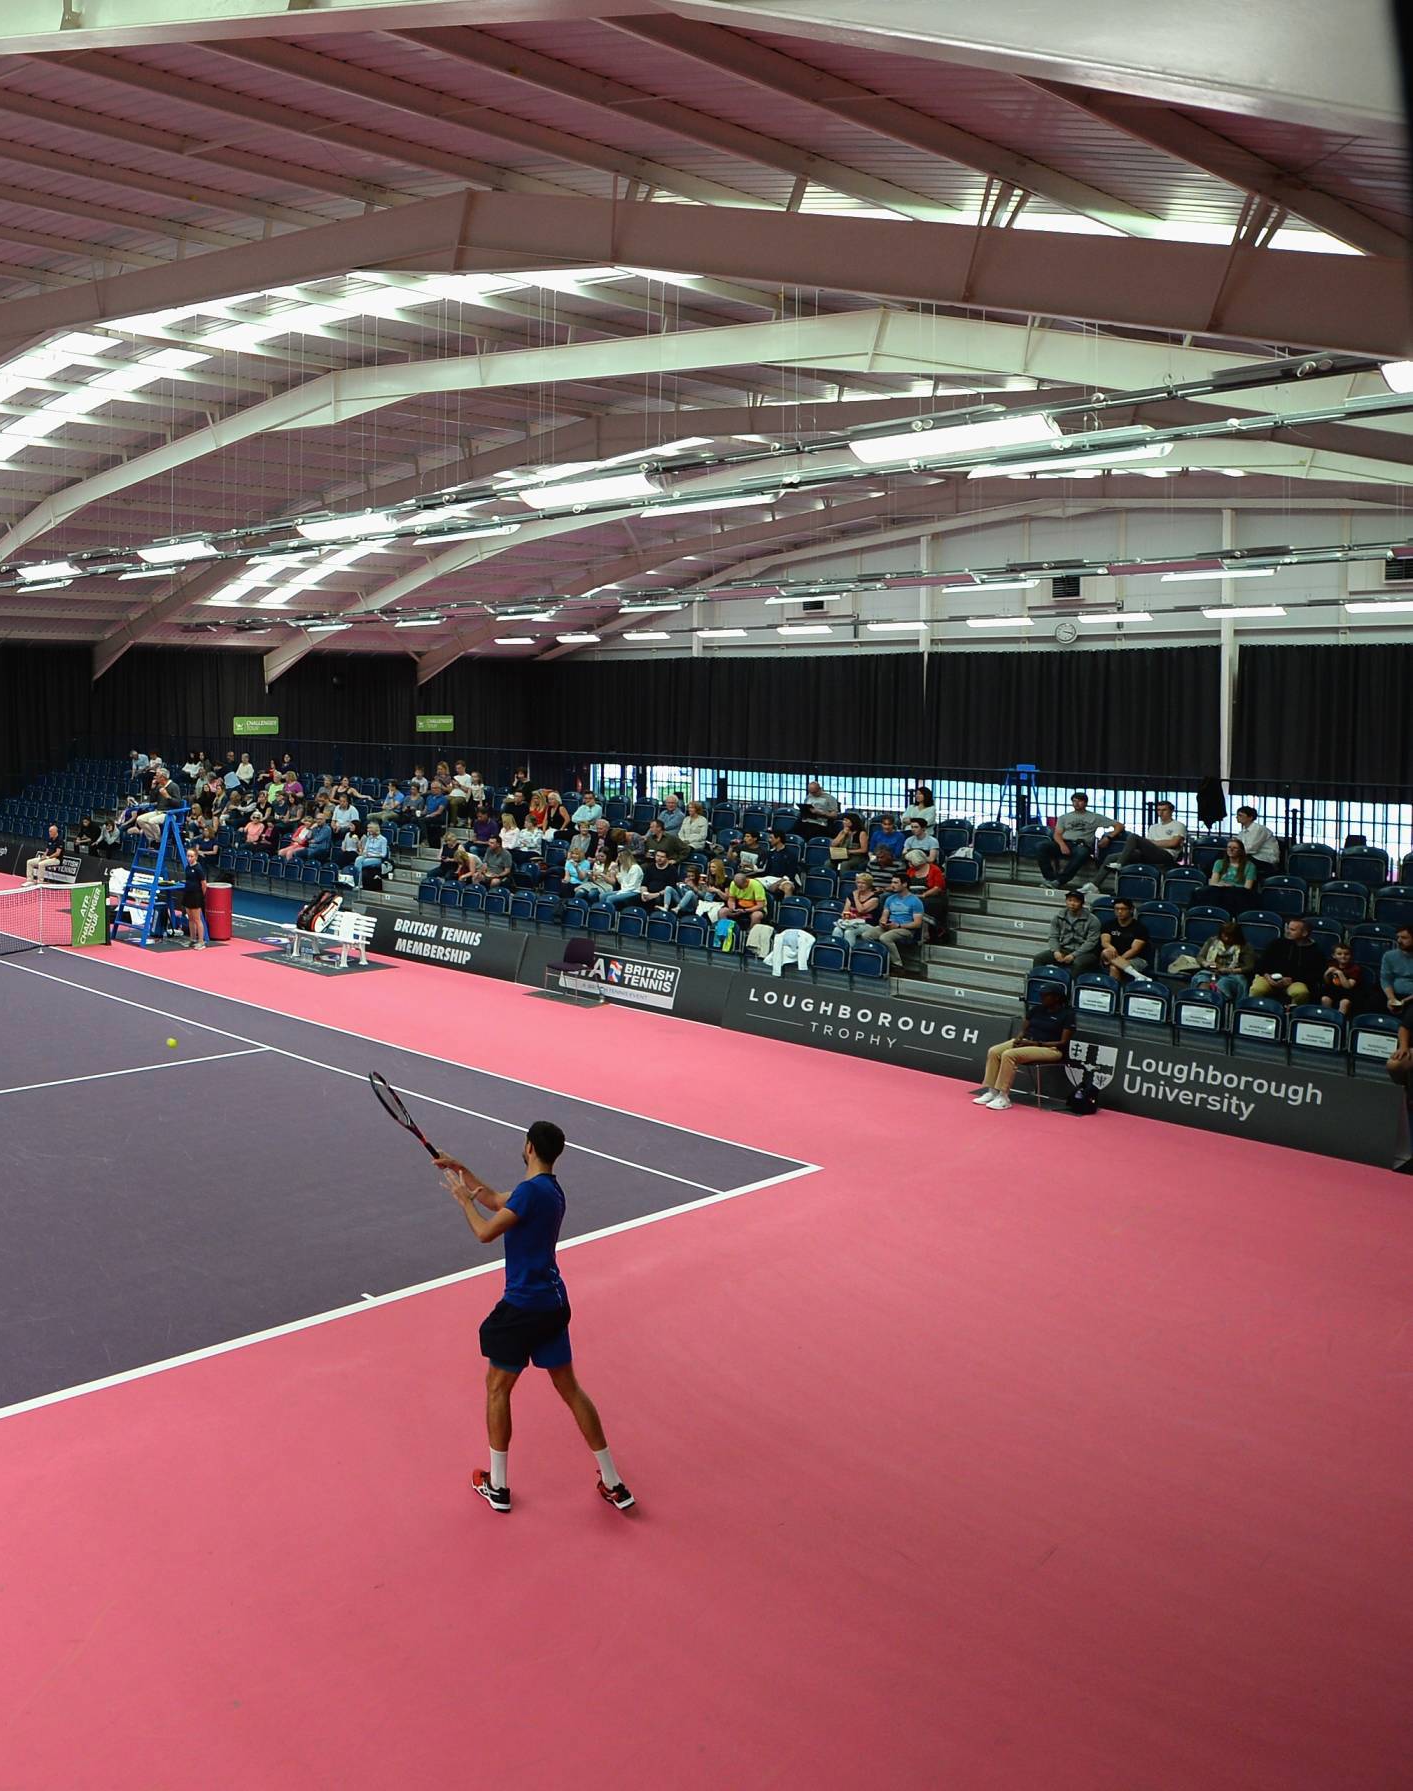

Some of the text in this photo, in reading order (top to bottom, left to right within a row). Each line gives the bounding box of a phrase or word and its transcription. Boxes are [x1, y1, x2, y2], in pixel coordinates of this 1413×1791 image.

[80, 887, 101, 944] CHALLENGER
[88, 913, 99, 937] TOUR
[394, 918, 482, 946] BRITISH TENNIS
[395, 938, 472, 965] MEMBERSHIP
[623, 974, 672, 993] TENNIS
[624, 963, 675, 982] BRITISH
[748, 988, 979, 1045] LOUGHBOROUGH
[809, 1022, 898, 1049] TROPHY
[1126, 1050, 1324, 1106] Loughborough
[1123, 1073, 1255, 1121] University
